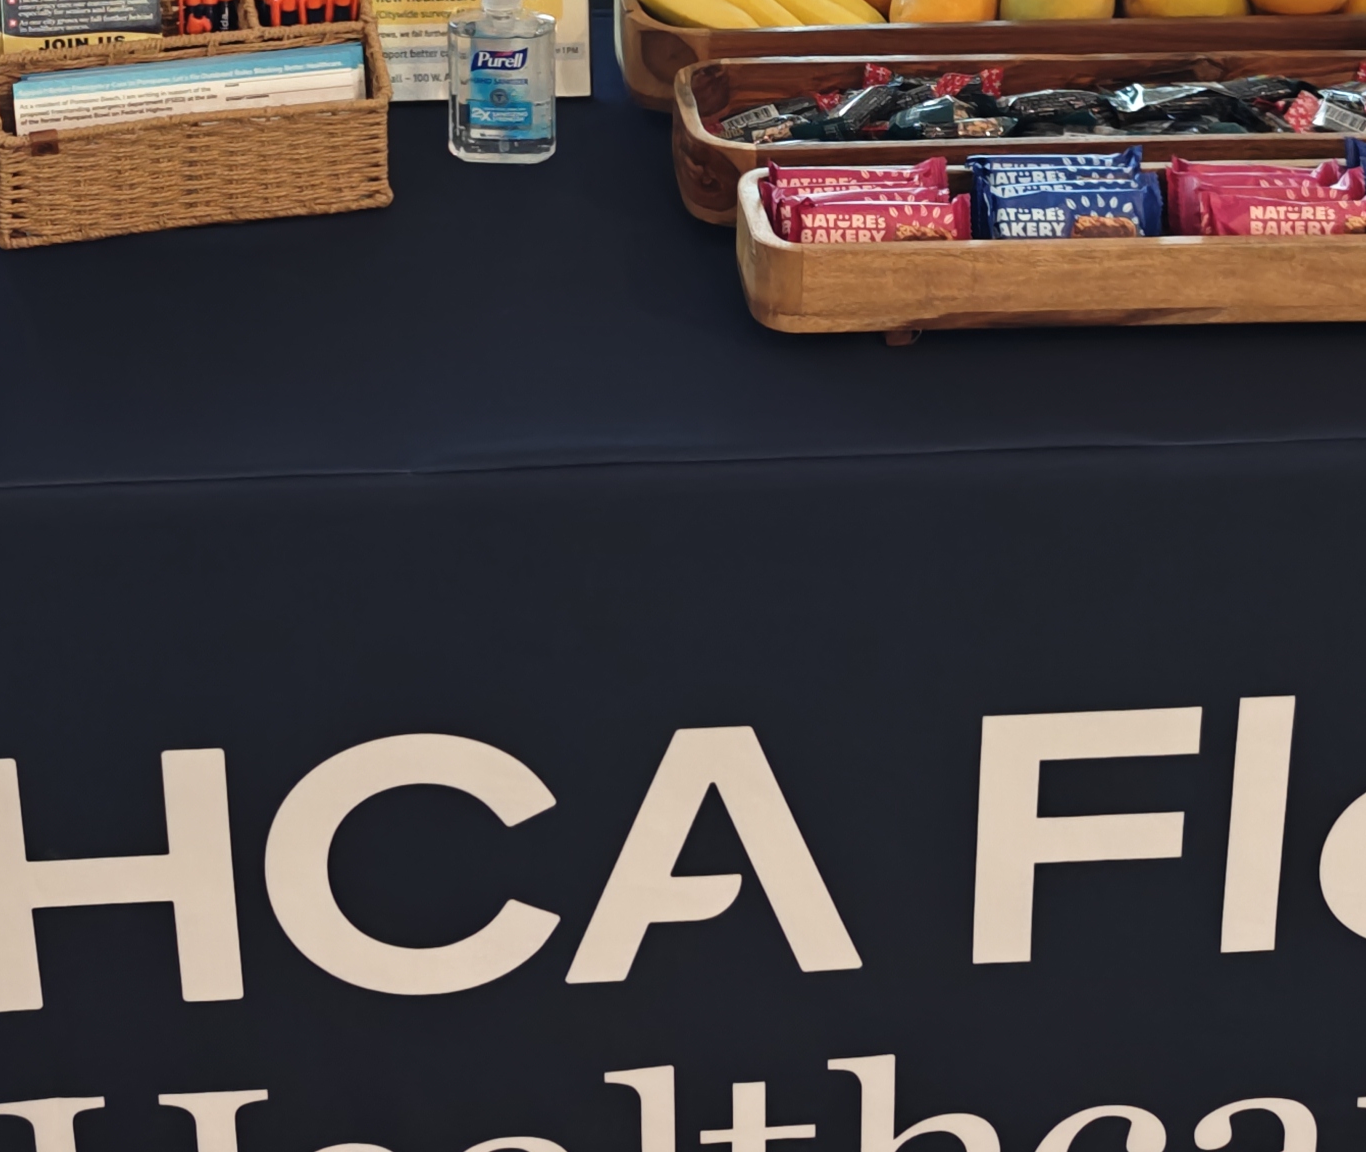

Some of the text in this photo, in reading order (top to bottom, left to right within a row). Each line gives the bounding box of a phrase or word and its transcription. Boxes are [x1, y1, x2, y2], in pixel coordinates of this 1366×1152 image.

[39, 37, 88, 50] JOIN
[477, 52, 523, 67] Purell
[1250, 220, 1335, 236] BAKERY
[801, 230, 886, 243] BAKERY
